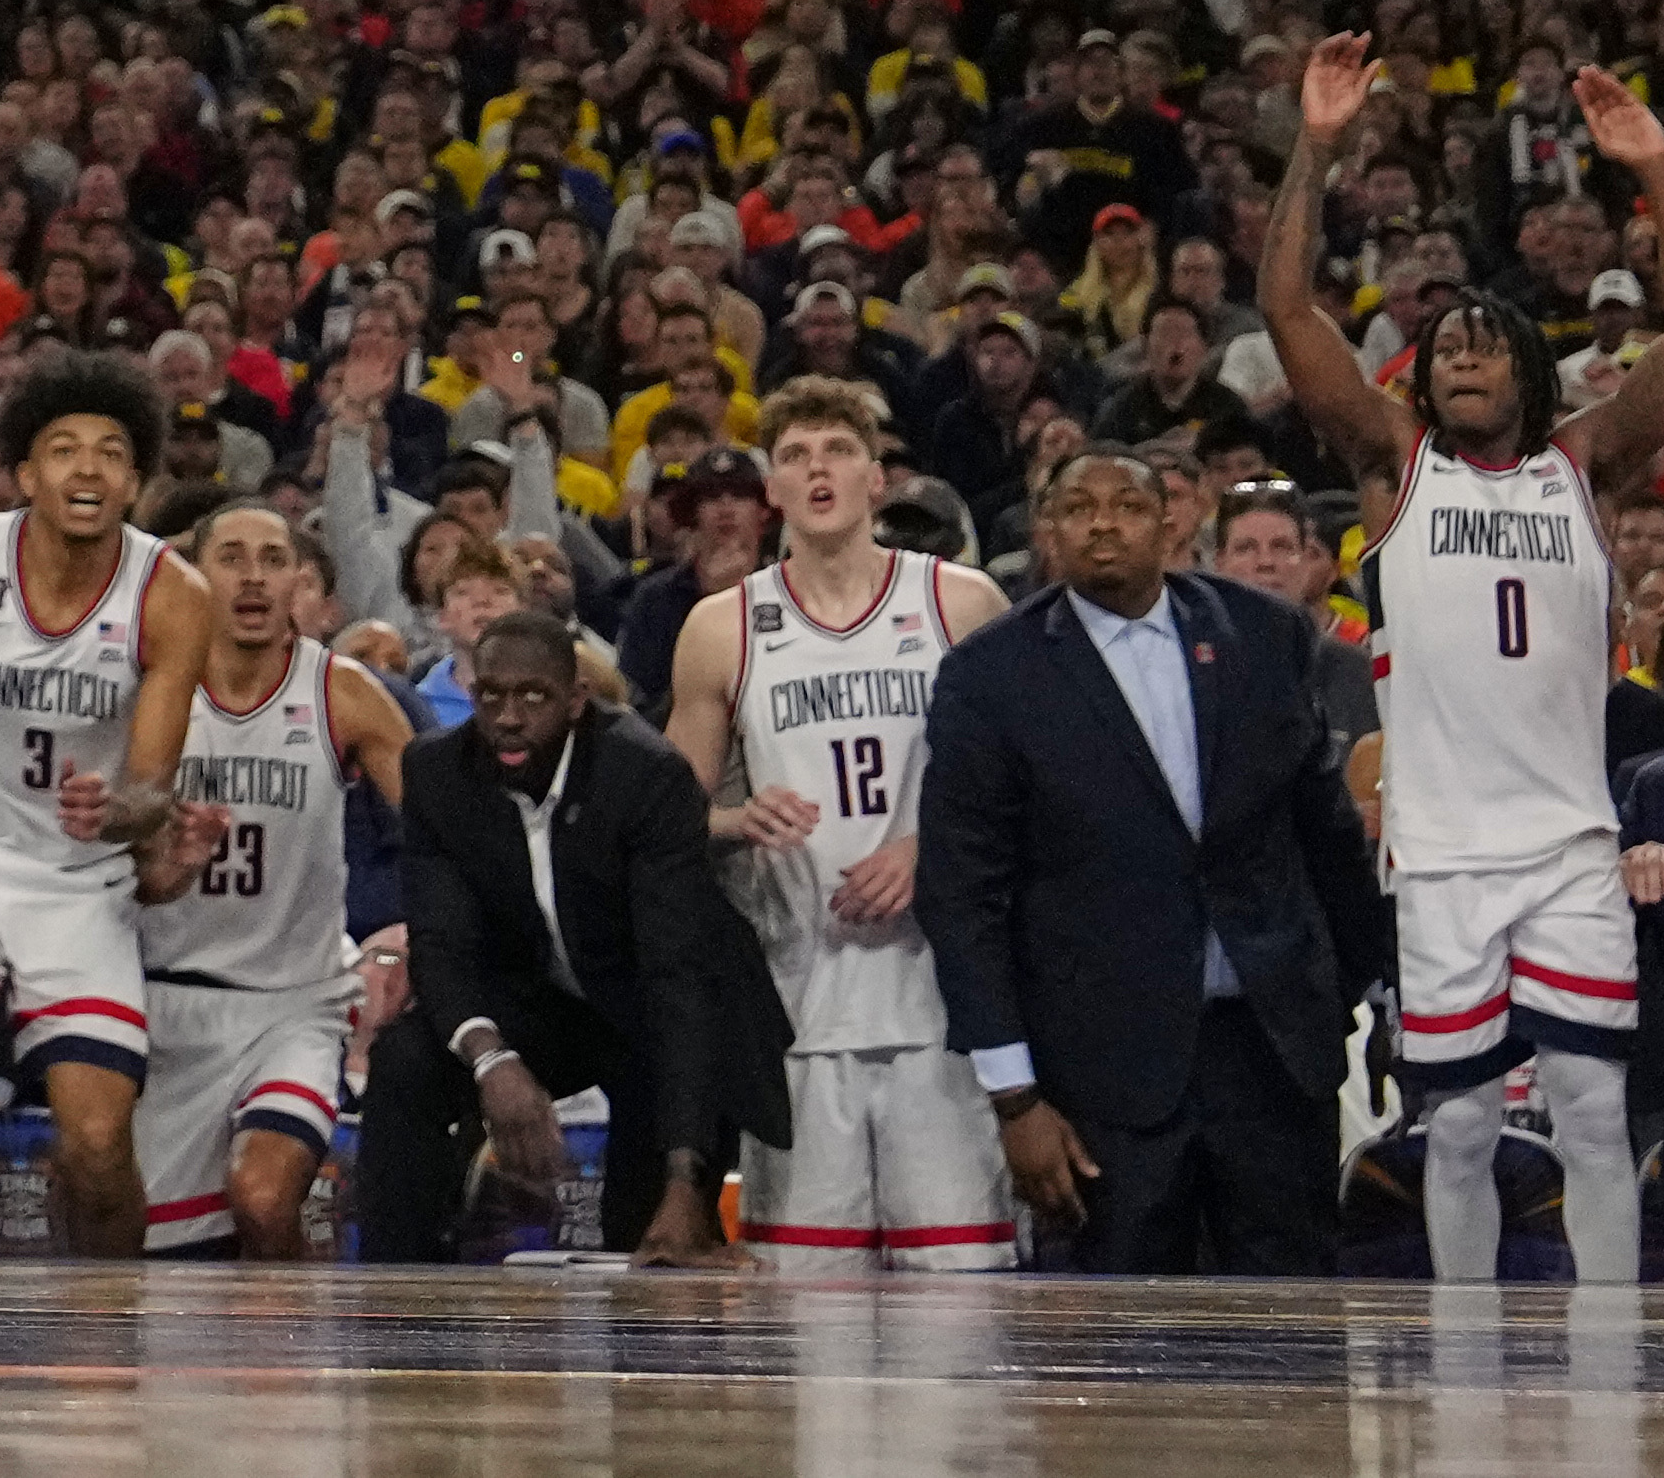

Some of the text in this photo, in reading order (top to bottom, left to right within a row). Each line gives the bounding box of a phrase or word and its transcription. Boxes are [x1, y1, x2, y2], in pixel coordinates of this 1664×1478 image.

[1429, 505, 1577, 567] CONNECTICUT
[1494, 576, 1531, 660] 0
[22, 724, 65, 790] 3
[830, 735, 890, 820] 12
[200, 822, 264, 898] 23
